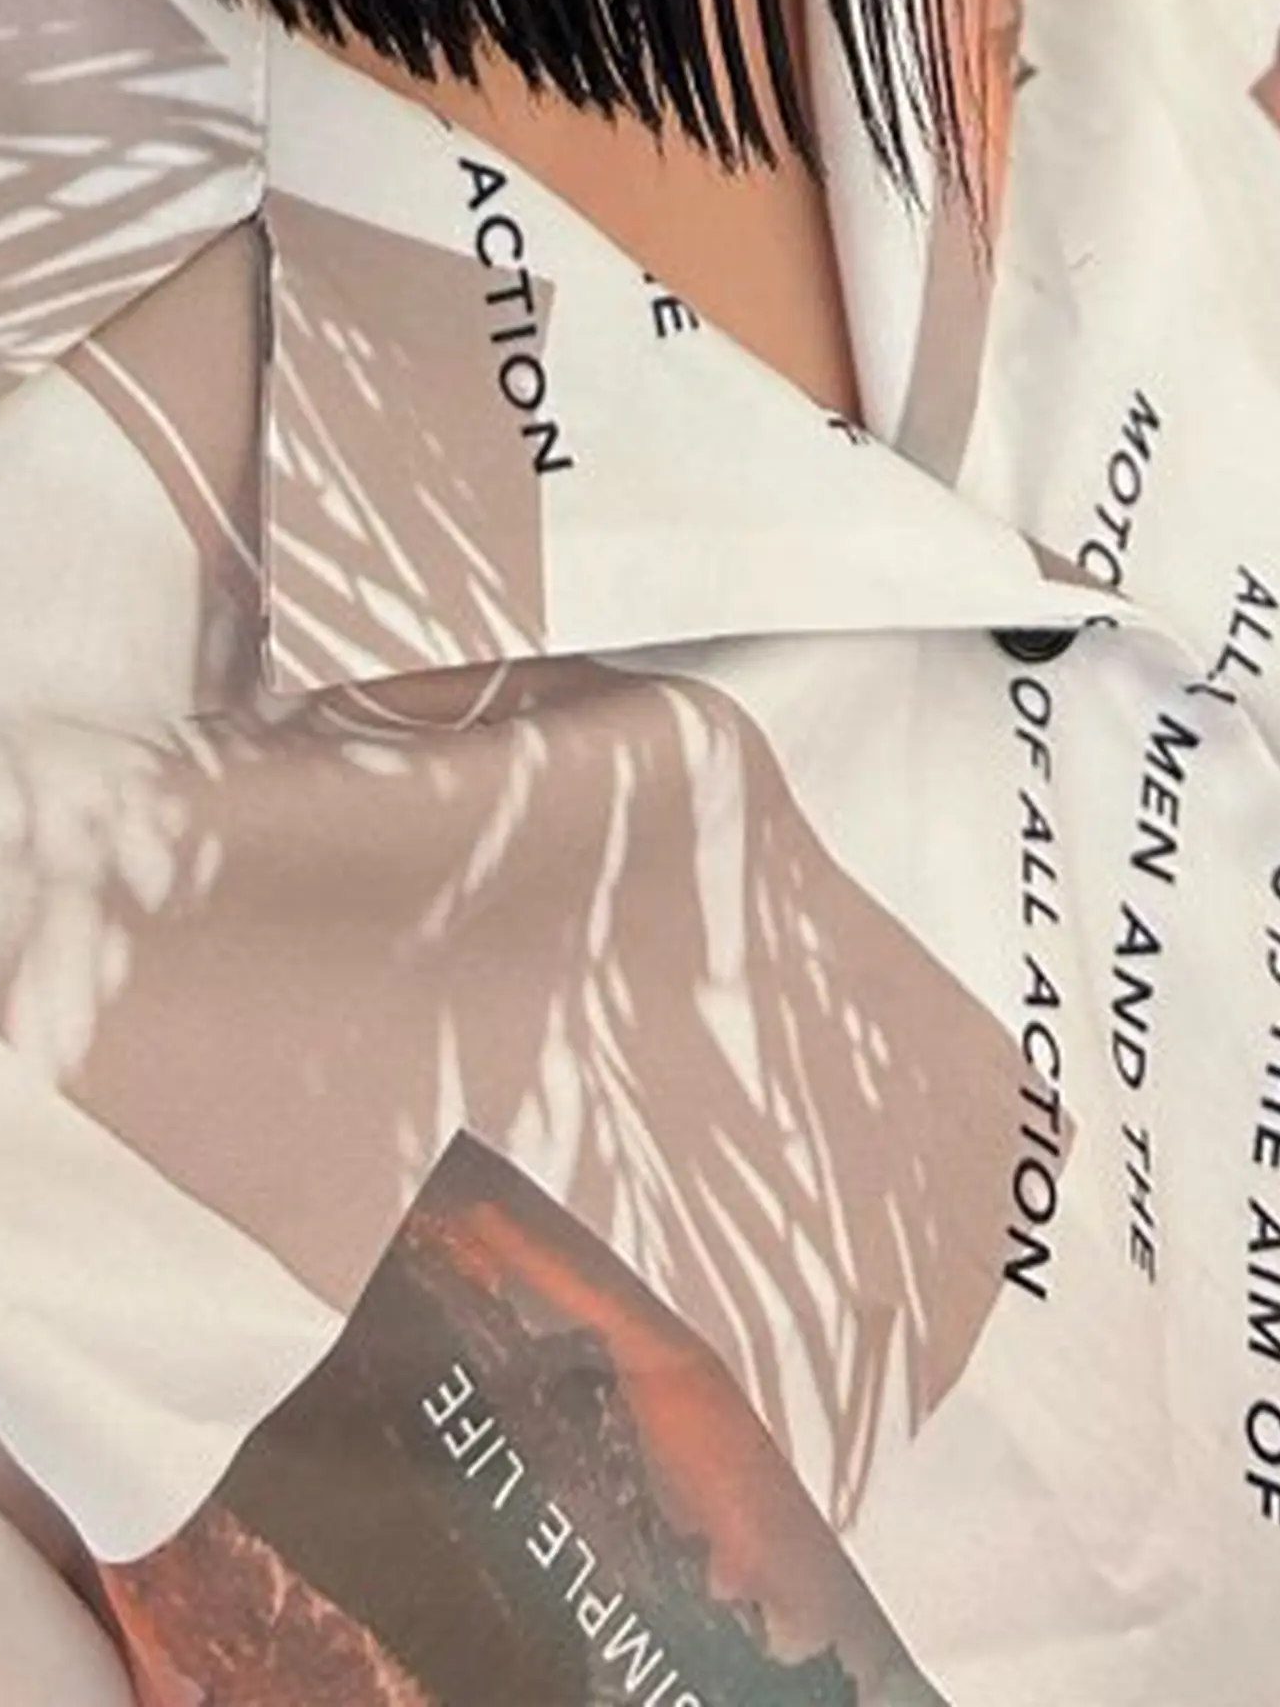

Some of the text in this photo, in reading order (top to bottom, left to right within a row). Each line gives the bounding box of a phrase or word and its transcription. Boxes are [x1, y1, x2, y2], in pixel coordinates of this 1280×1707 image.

[457, 156, 574, 476] ACTION
[1007, 674, 1053, 783] OF
[1129, 712, 1201, 885] MEN
[1018, 789, 1061, 928] ALL
[1111, 901, 1163, 1090] AND
[1001, 953, 1062, 1302] ACTION
[1122, 1123, 1157, 1285] THE
[421, 1363, 524, 1511] LIFE
